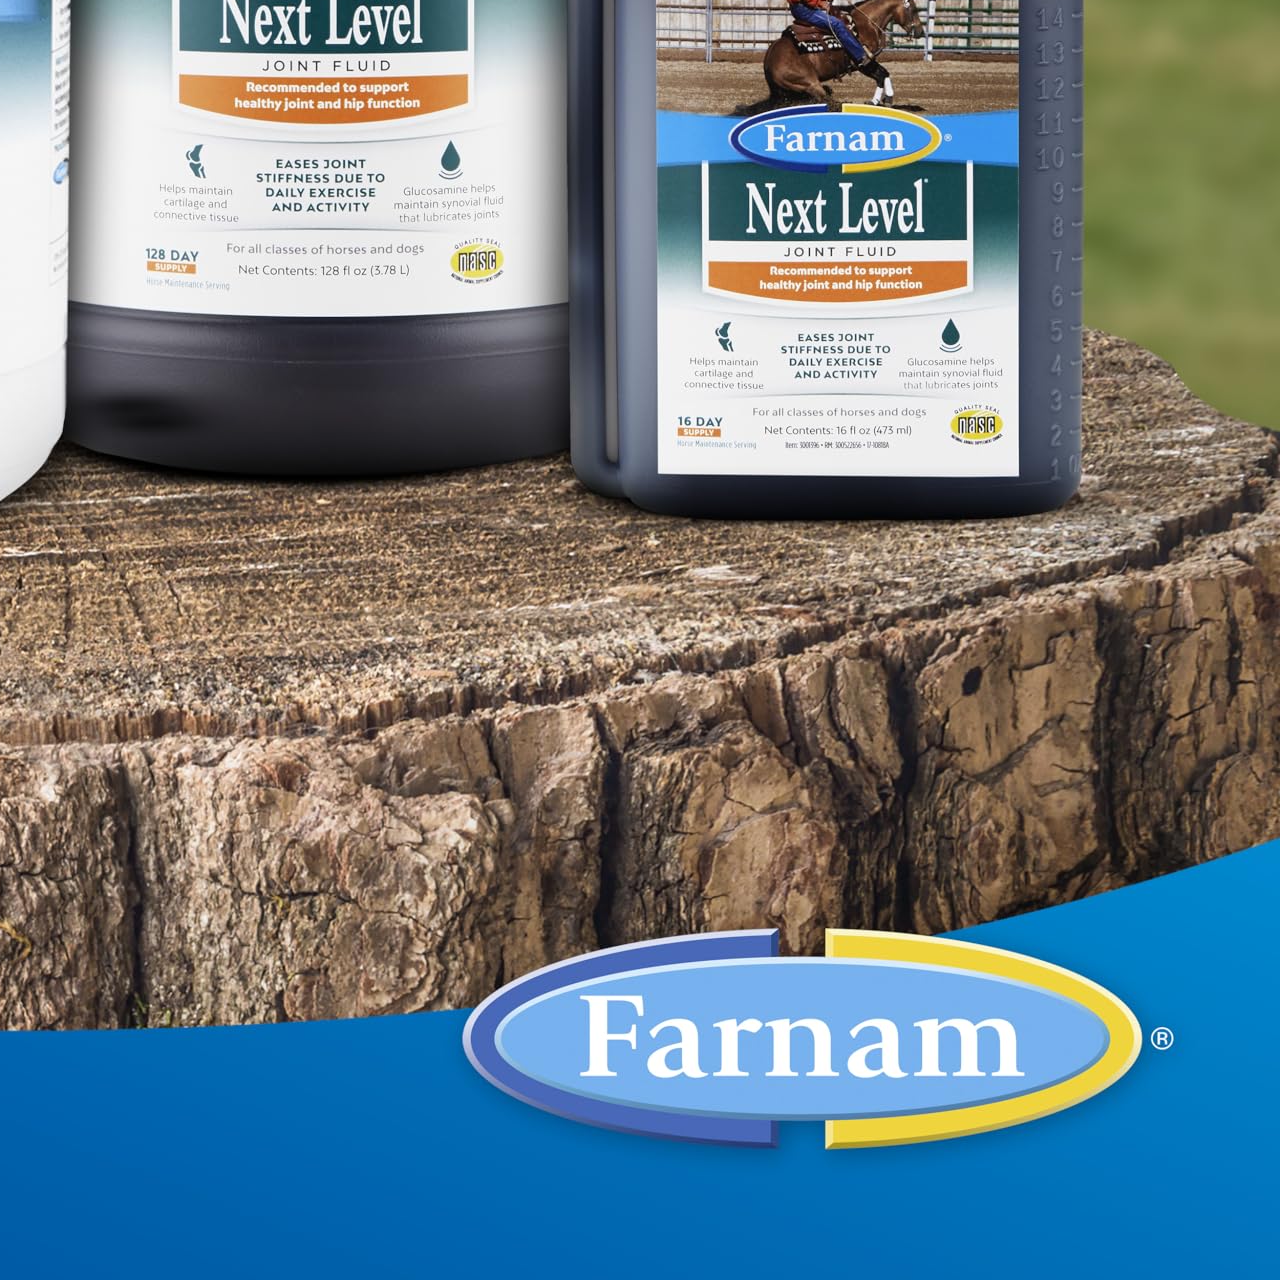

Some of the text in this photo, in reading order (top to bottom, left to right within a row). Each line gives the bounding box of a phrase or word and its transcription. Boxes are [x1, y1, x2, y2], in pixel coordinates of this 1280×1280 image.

[262, 60, 390, 71] JOINT FLUID
[246, 82, 408, 94] Recommended to support
[235, 97, 420, 111] healthy joint and hip function
[765, 125, 905, 151] Farnam
[746, 178, 925, 234] Next Level
[146, 248, 199, 261] 128 DAY
[784, 246, 895, 256] JOINT FLUID
[155, 263, 187, 272] SUPPLY
[239, 265, 258, 274] Net
[262, 265, 316, 275] Contents:
[321, 266, 339, 275] 128
[343, 265, 349, 275] fl
[370, 265, 396, 276] (3.78
[400, 264, 409, 276] L)
[770, 265, 912, 276] Recommended to support
[760, 279, 922, 291] healthy joint and hip function
[798, 333, 874, 341] EASES JOINT
[781, 345, 890, 353] STIFFNESS DUE TO
[794, 370, 876, 378] AND ACTIVITY
[678, 416, 722, 426] 16 DAY
[765, 426, 782, 434] Net
[786, 426, 833, 434] Contents:
[836, 426, 846, 434] 16
[850, 425, 855, 434] fl
[873, 425, 893, 436] (473
[896, 425, 911, 435] ml)
